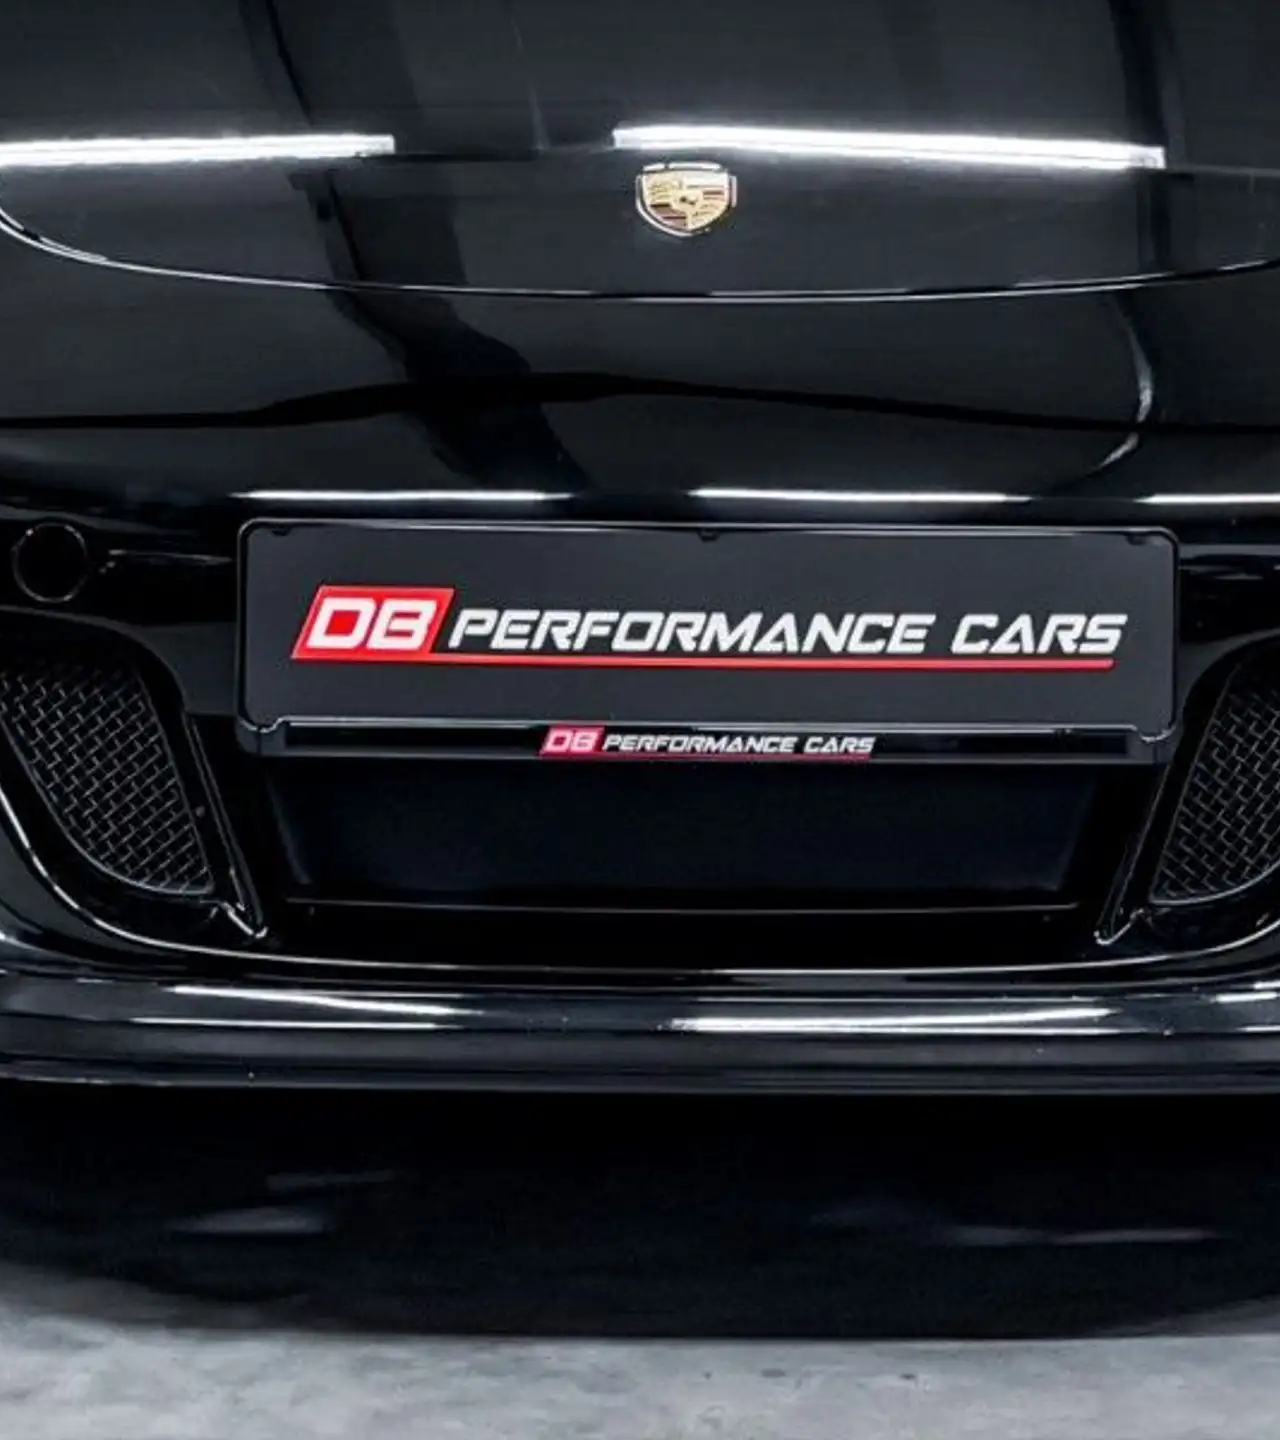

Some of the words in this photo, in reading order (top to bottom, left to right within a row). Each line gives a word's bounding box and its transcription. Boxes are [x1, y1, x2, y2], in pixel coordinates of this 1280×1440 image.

[307, 598, 436, 649] DB
[449, 609, 936, 653] PERFORMANCE
[951, 614, 1128, 653] CARS
[546, 731, 598, 752] DB
[602, 735, 798, 753] PERFORMANCE
[804, 737, 875, 753] CARS
